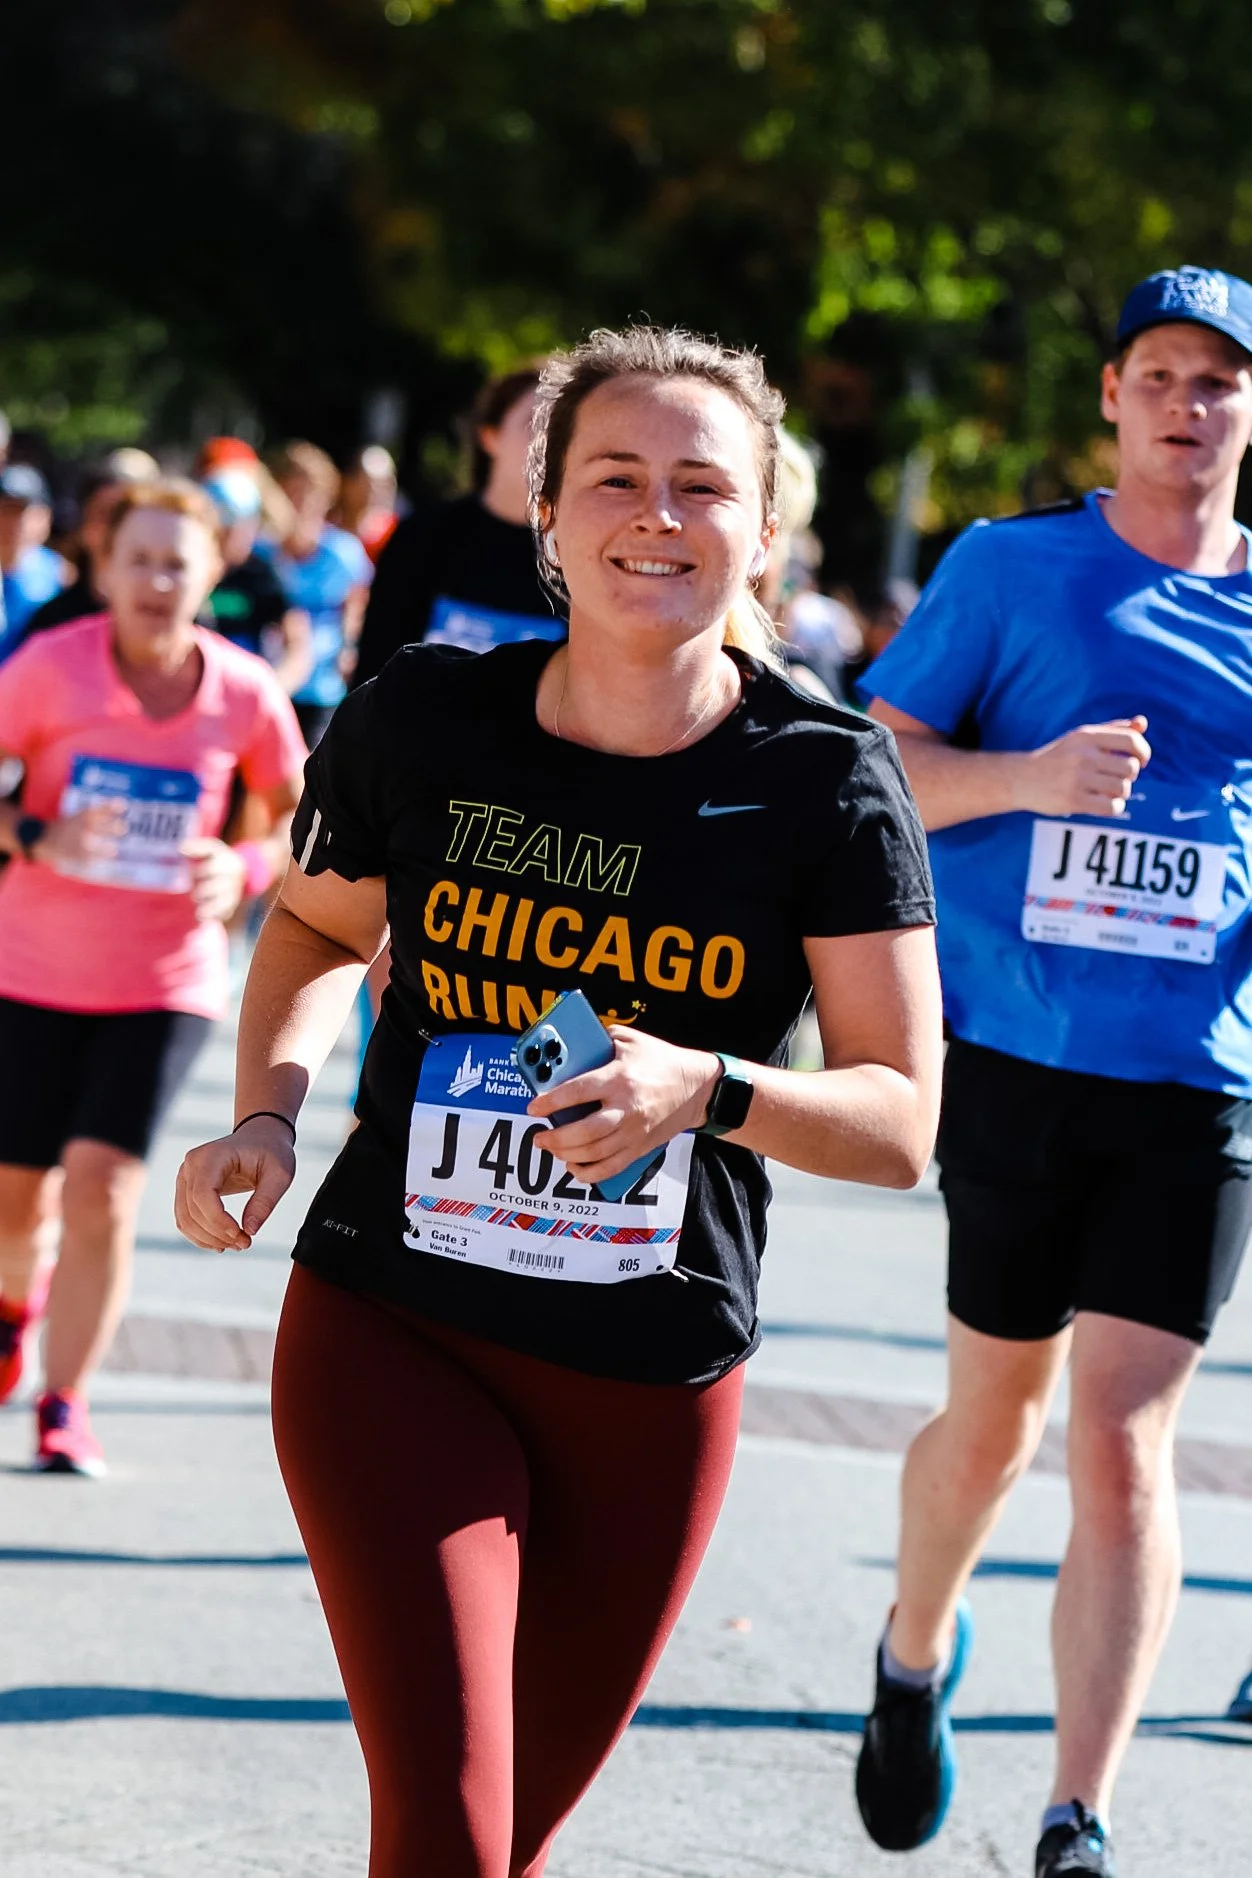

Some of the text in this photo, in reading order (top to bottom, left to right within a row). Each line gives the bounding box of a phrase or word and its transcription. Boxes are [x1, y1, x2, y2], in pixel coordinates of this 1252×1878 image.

[446, 800, 641, 896] TEAM
[1053, 829, 1200, 898] J 41159
[423, 880, 745, 999] CHICAGO
[421, 959, 556, 1030] RUN
[489, 1058, 509, 1066] BANK
[487, 1067, 525, 1085] Chica
[484, 1081, 535, 1098] Marath
[431, 1113, 667, 1206] J 402
[489, 1192, 599, 1216] OCTOBER 9, 2022
[431, 1230, 468, 1247] Gate 3
[429, 1242, 467, 1258] Van Buren
[618, 1258, 640, 1271] 805
